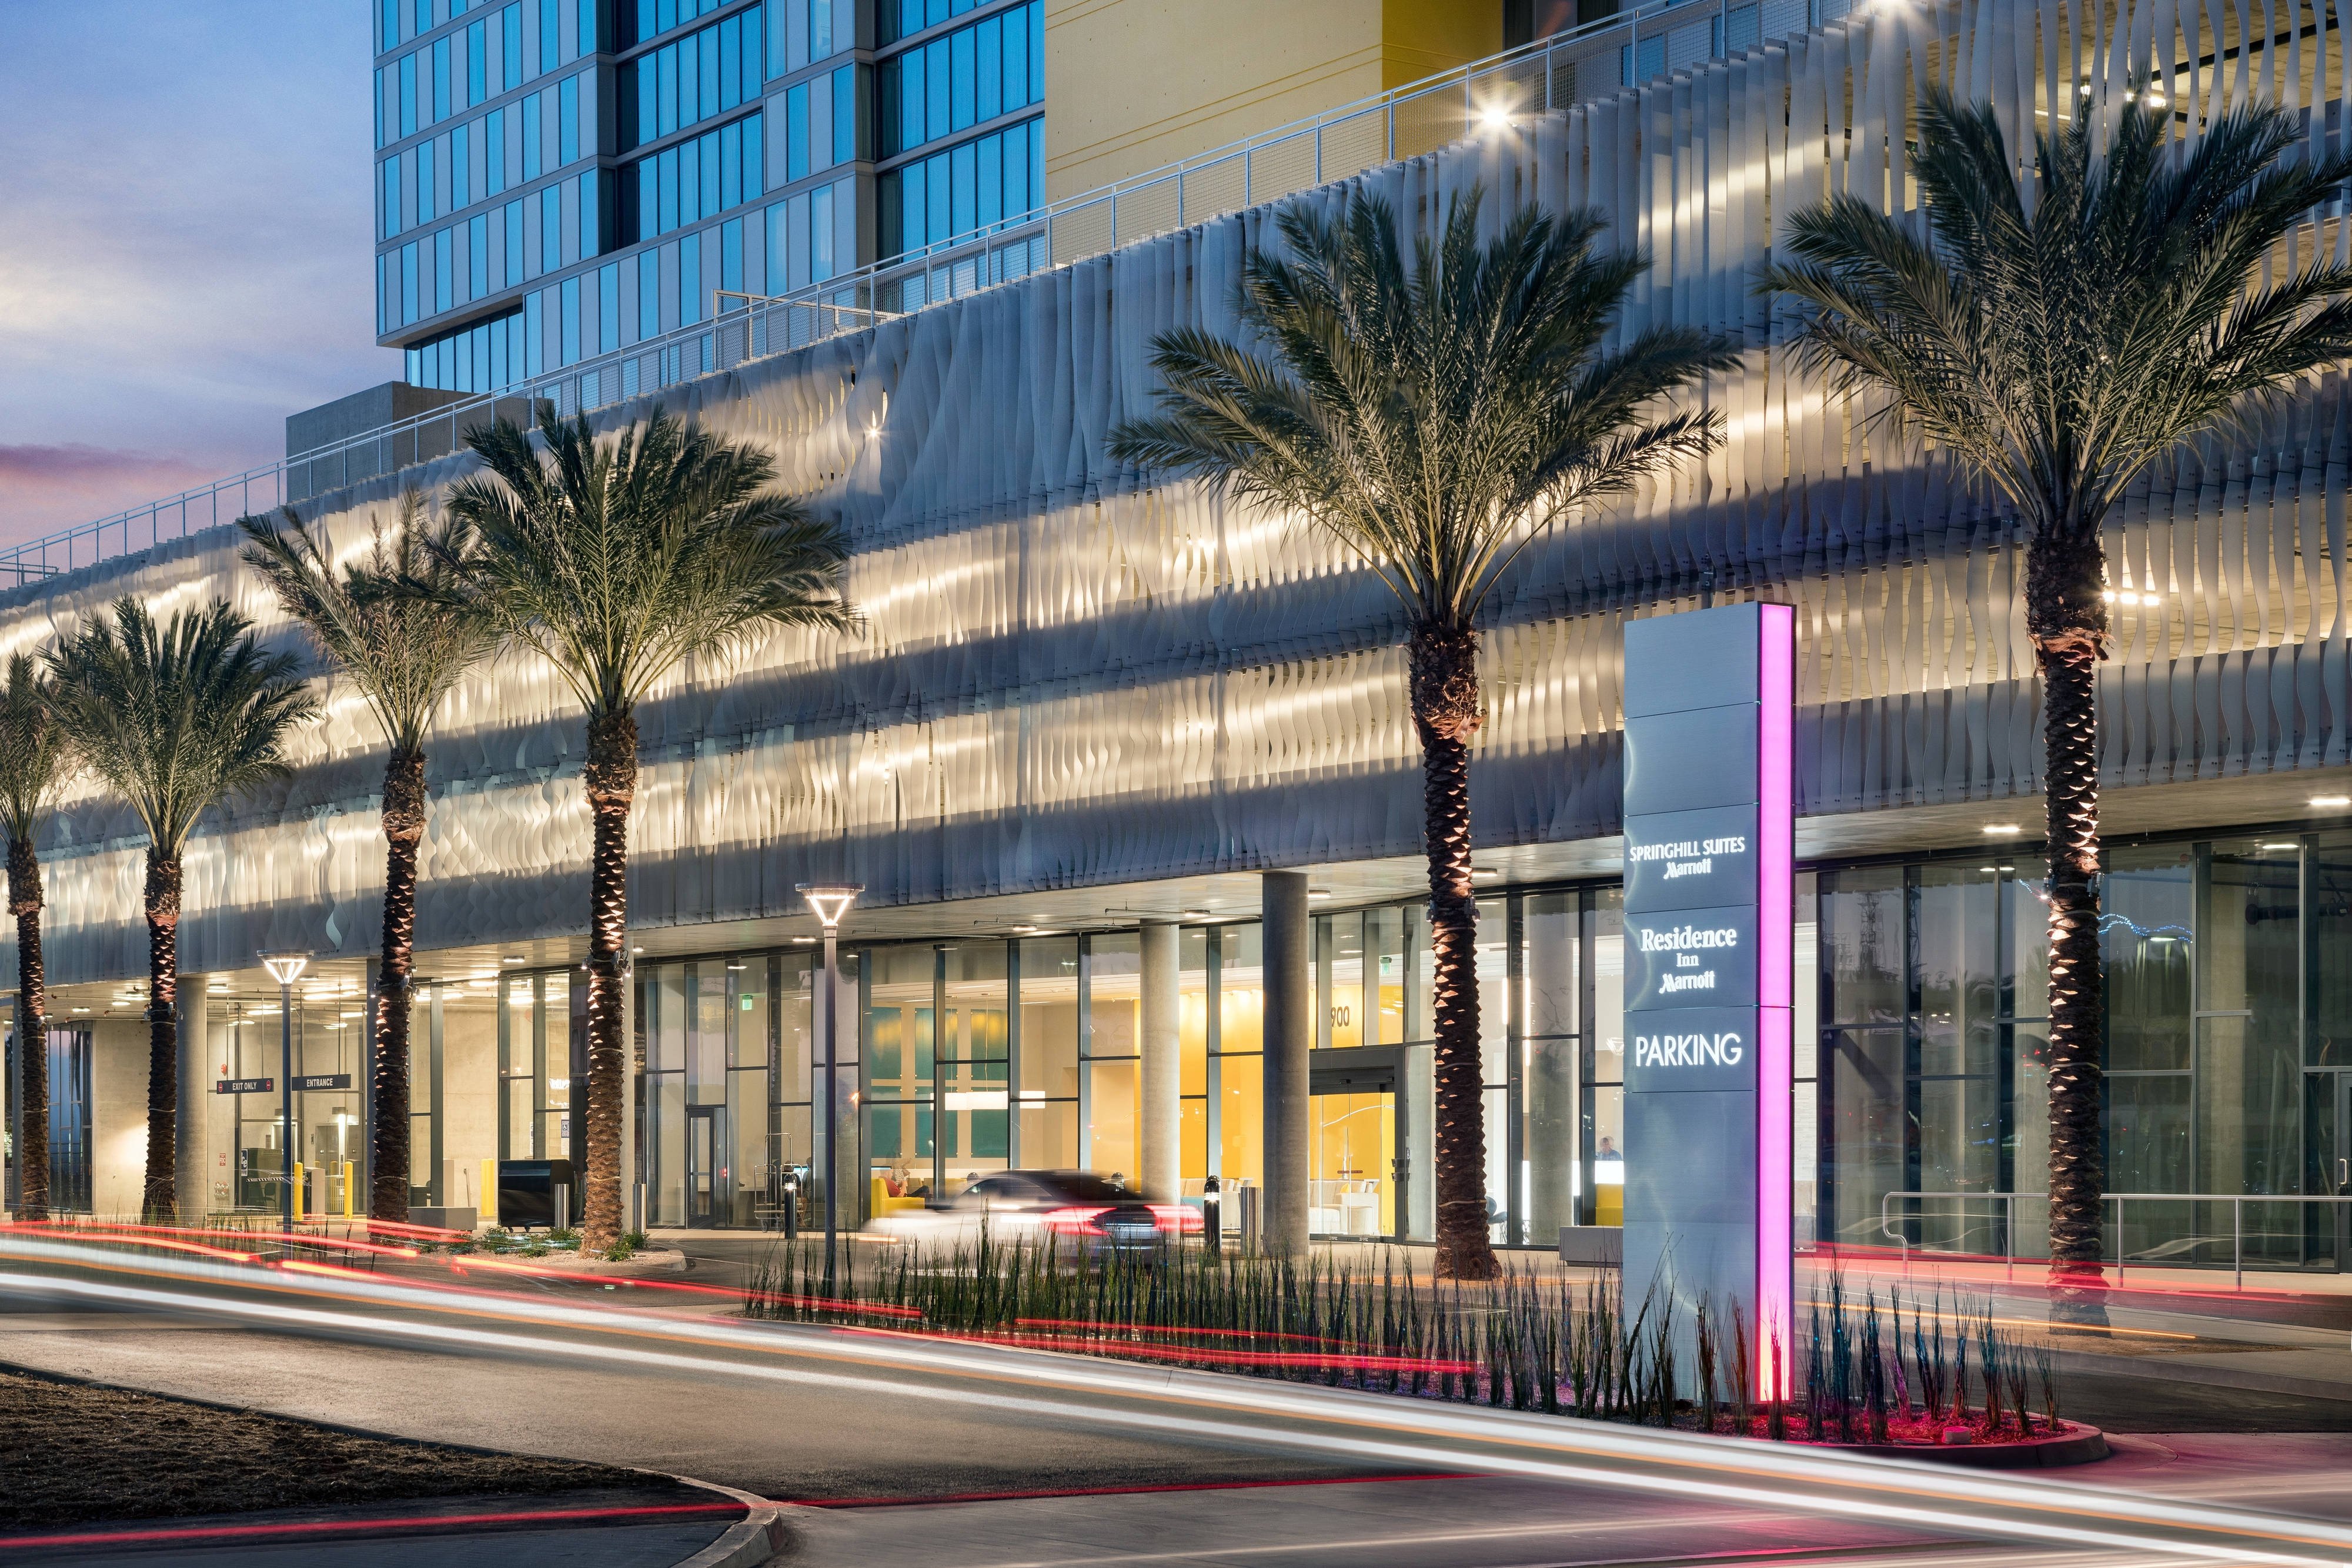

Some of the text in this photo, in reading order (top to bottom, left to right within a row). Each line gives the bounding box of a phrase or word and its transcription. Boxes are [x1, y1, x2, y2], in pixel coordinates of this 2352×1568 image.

[1629, 837, 1745, 861] SPRINGHILL SUITES
[1663, 858, 1711, 880] Marriott
[1641, 925, 1736, 951] Residence
[1676, 953, 1699, 967] Inn
[1659, 971, 1715, 994] Marriott
[1331, 1006, 1349, 1027] 900
[1636, 1033, 1742, 1066] PARKING
[232, 1082, 257, 1091] EXIT ONLY
[306, 1078, 333, 1087] ENTRANCE
